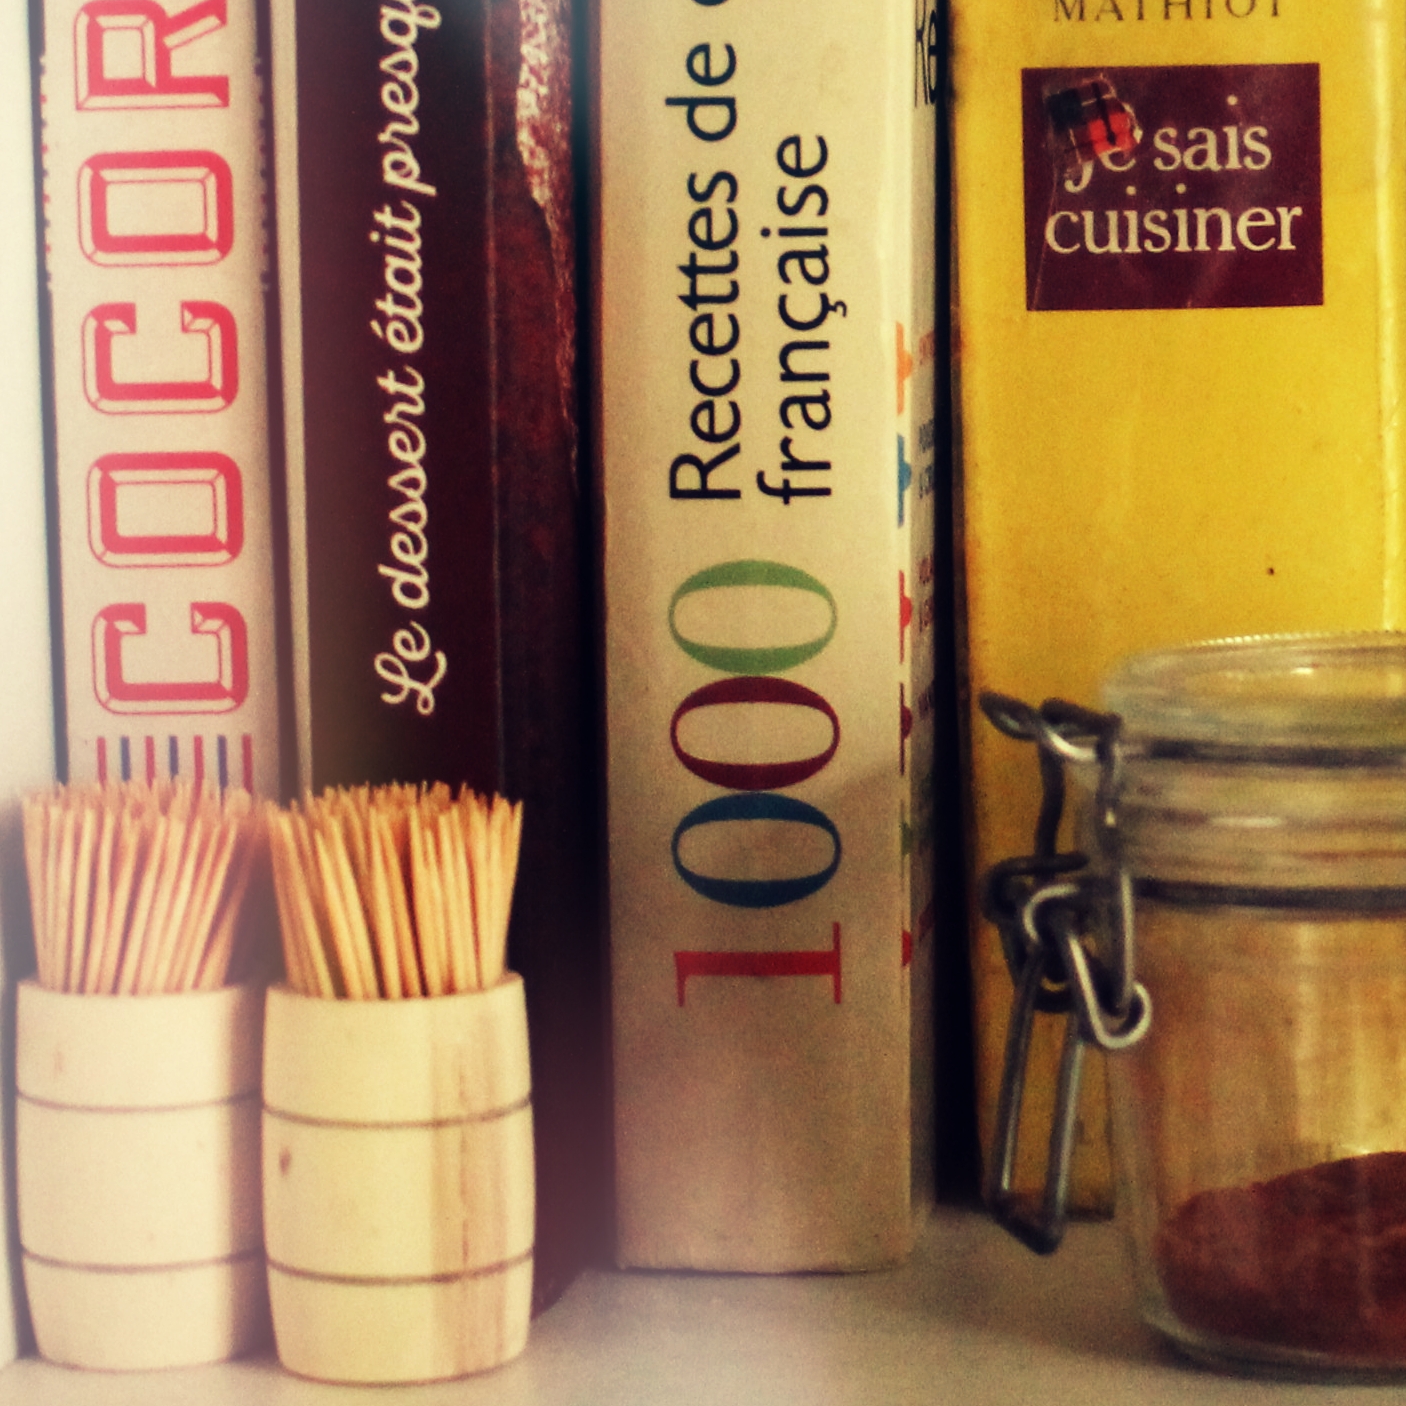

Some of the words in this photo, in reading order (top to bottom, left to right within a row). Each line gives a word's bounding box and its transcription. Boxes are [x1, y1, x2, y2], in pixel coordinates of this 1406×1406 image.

[665, 43, 738, 141] de
[1153, 94, 1273, 172] sais
[370, 200, 425, 354] était
[1044, 184, 1303, 254] cuisiner
[669, 171, 741, 499] Recettes
[756, 134, 847, 505] française
[378, 367, 430, 610] dessert
[375, 621, 446, 715] Le
[668, 559, 842, 1008] 1000
